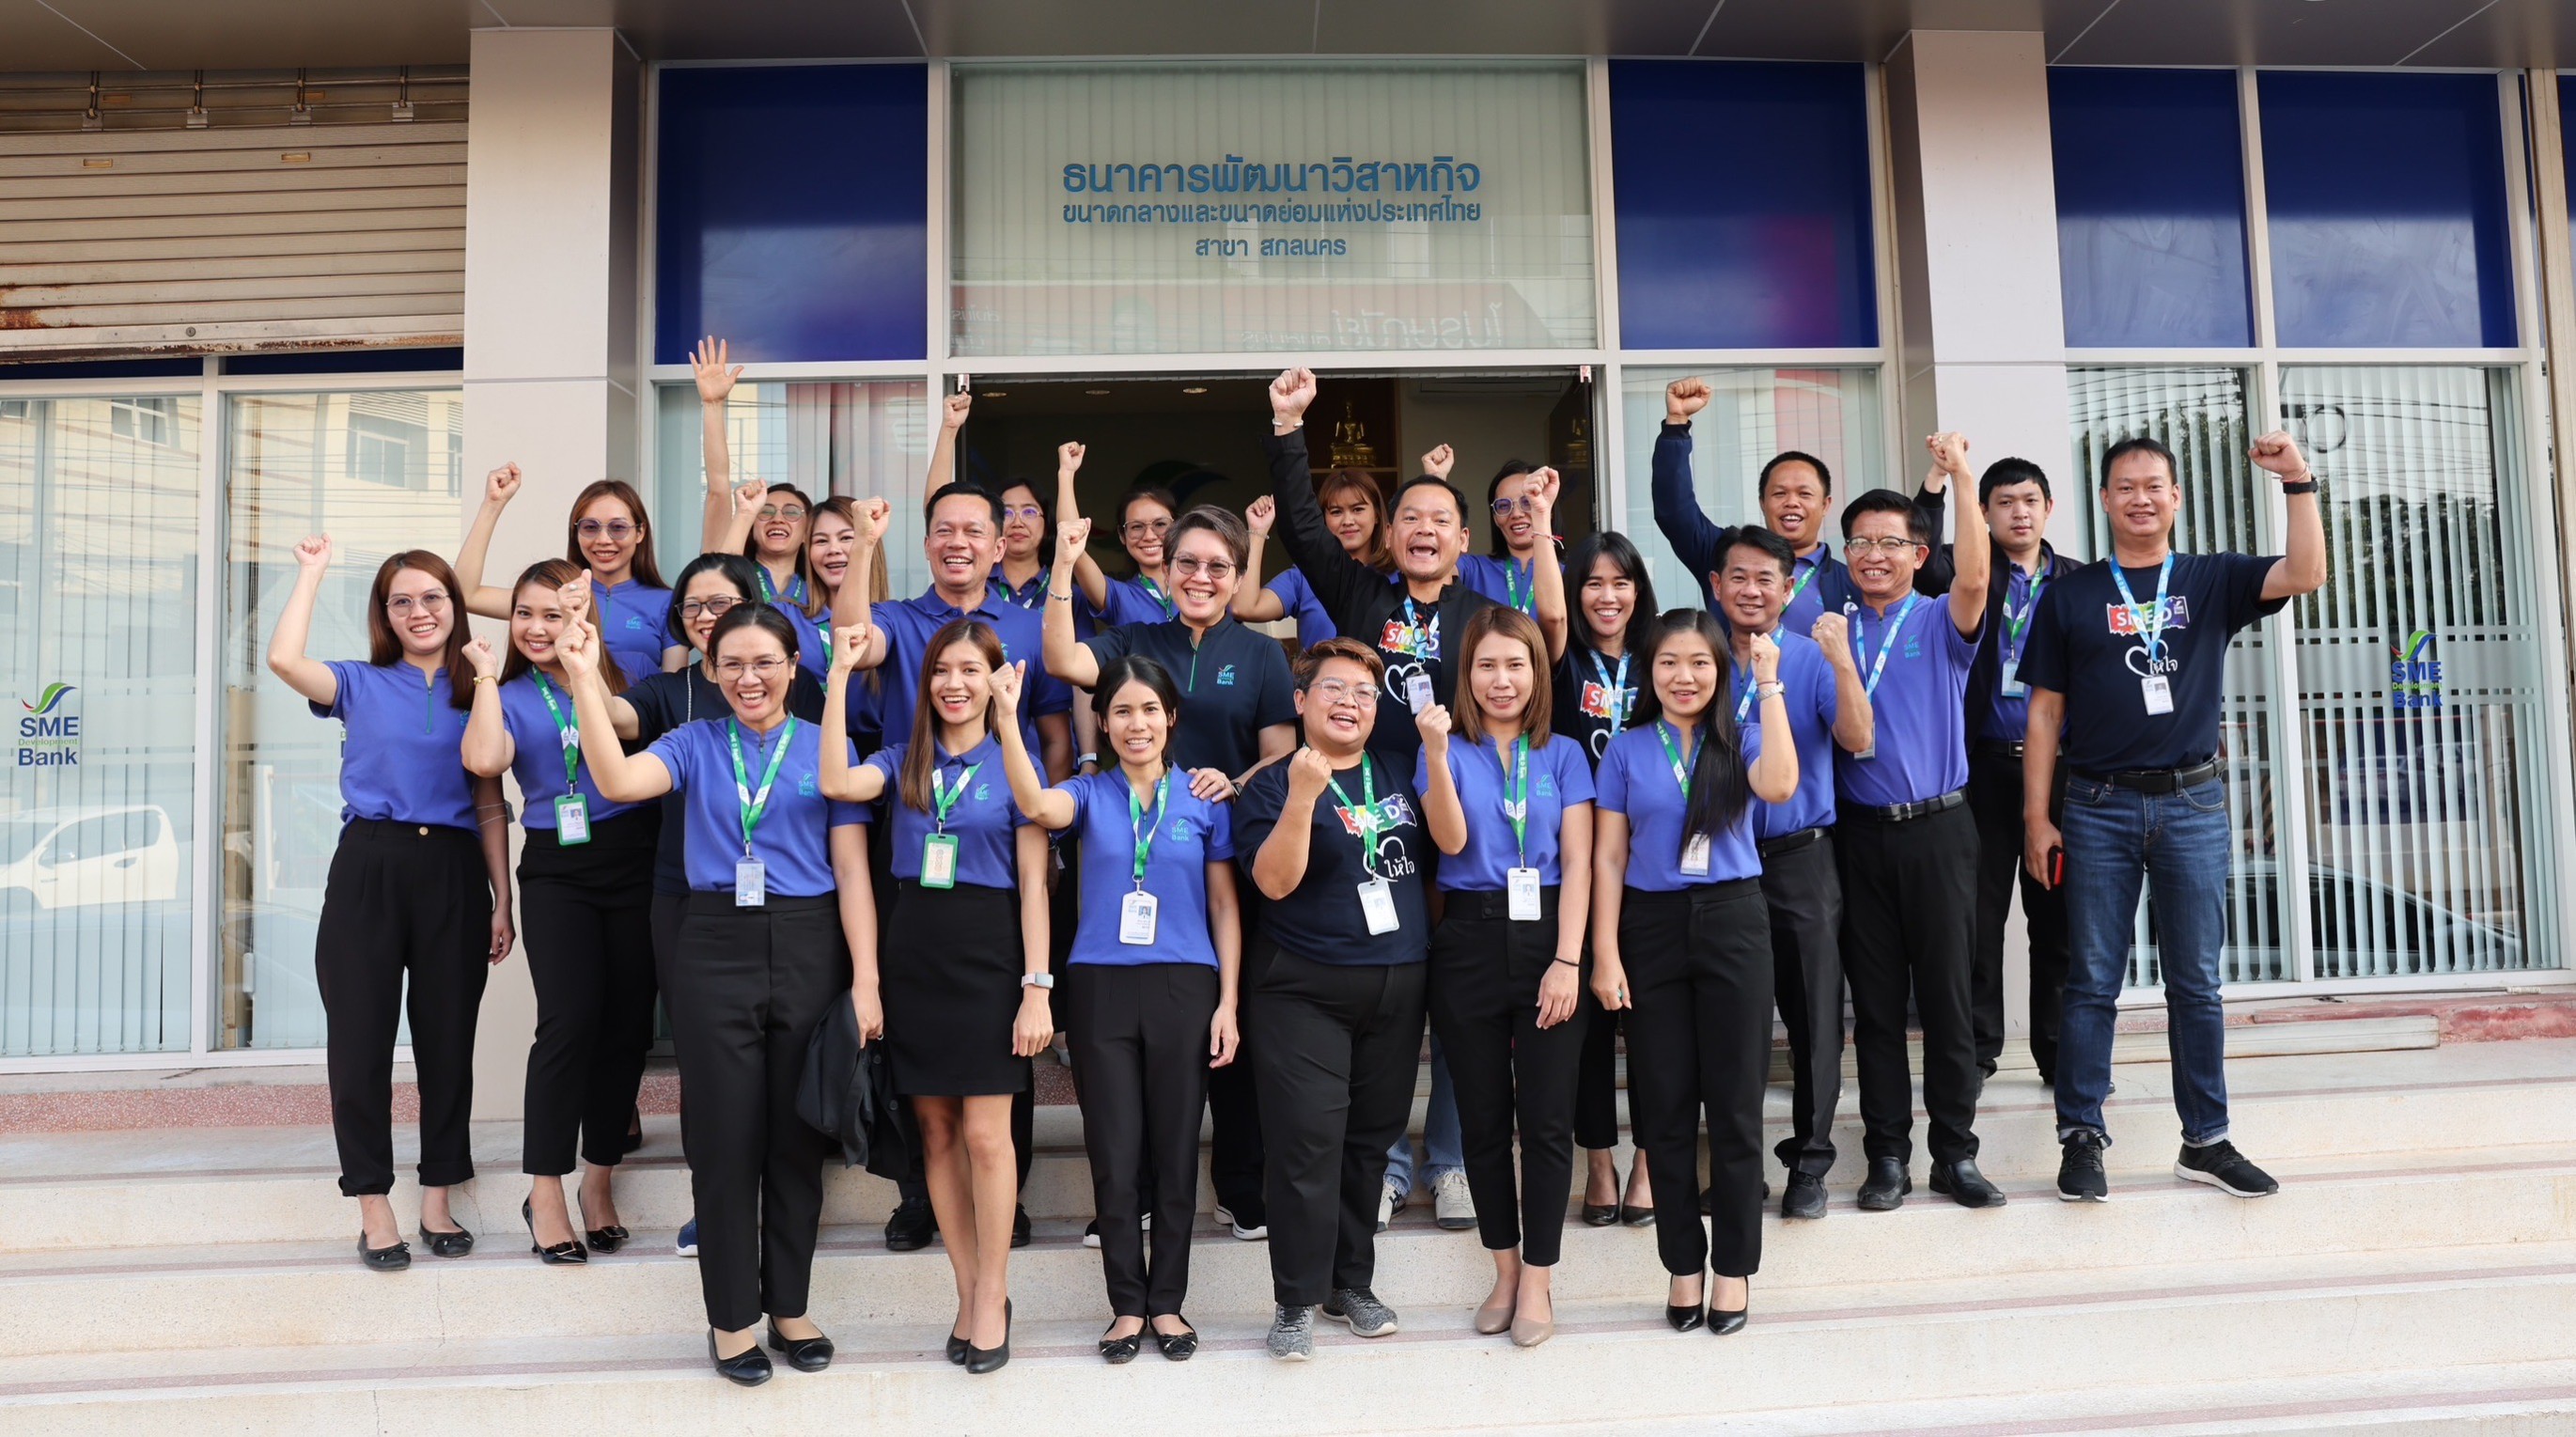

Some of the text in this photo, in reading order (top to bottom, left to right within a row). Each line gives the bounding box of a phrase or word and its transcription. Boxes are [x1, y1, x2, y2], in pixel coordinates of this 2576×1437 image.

[1063, 154, 1481, 194] ธนาคารพัฒนาวิสาหกิจ
[1063, 195, 1481, 223] ขนาดกลางและขนาดย่อมแห่งประเทศไทย
[1195, 237, 1347, 257] สาขา สกลนคร
[2392, 662, 2443, 682] SME
[2393, 691, 2443, 709] Bank
[20, 716, 79, 738] SME
[19, 739, 78, 747] Development
[19, 747, 78, 766] Bank
[1171, 834, 1190, 842] Bank
[1384, 856, 1414, 878] ให้ใจ
